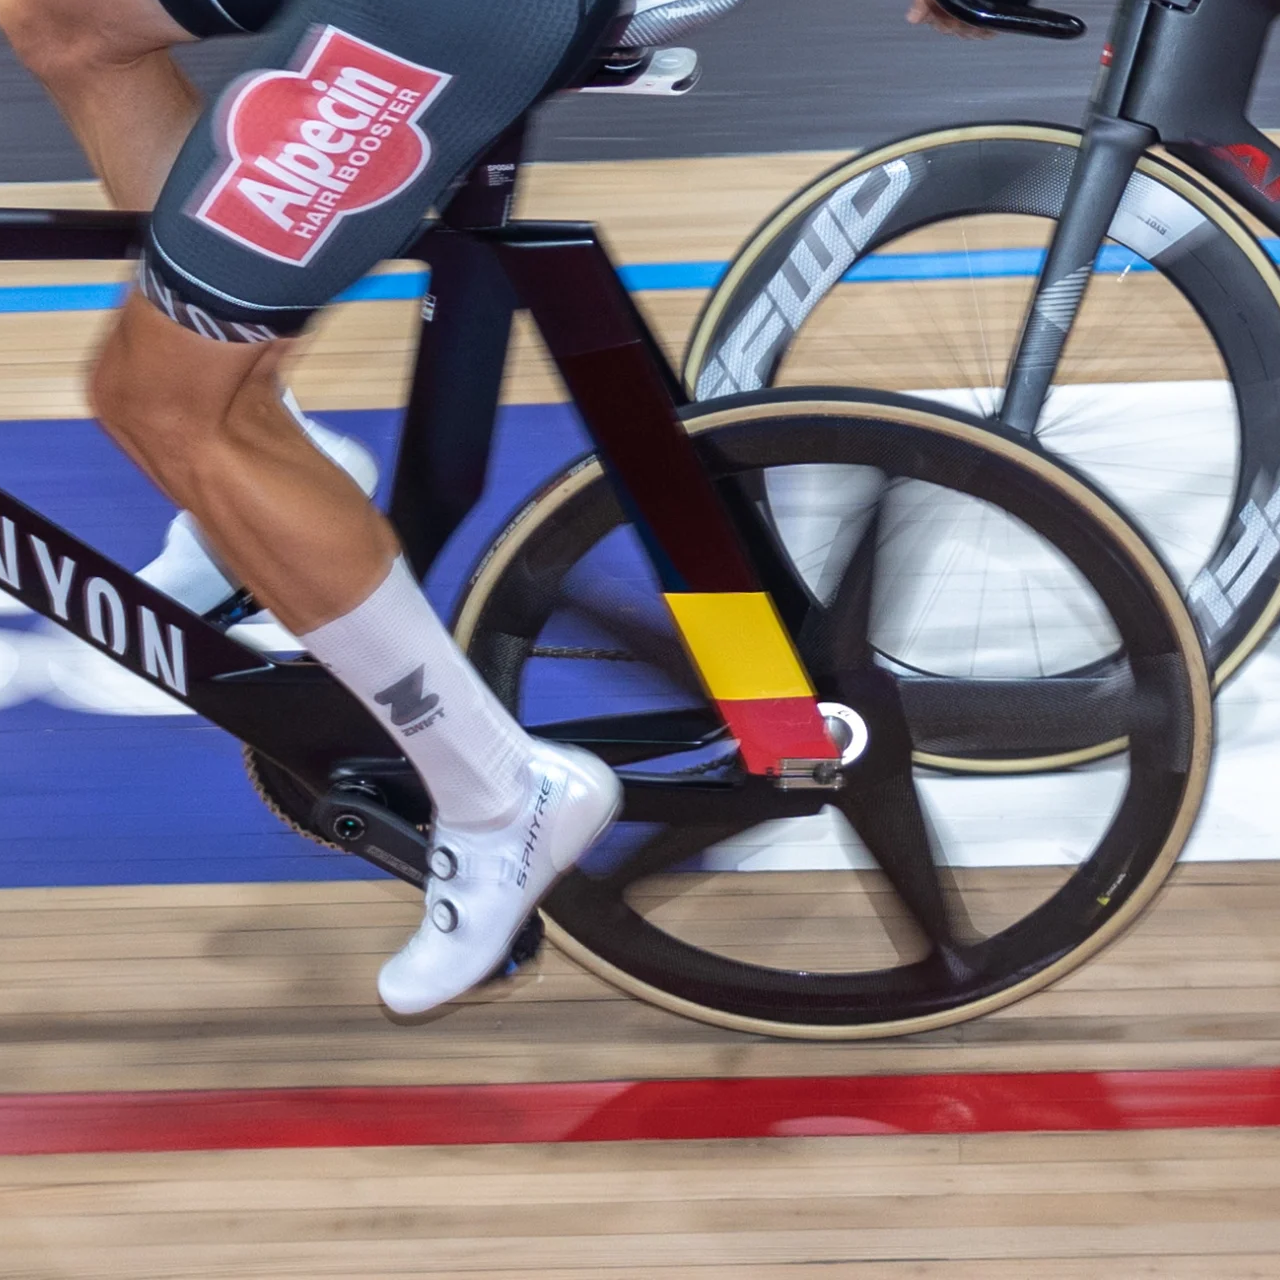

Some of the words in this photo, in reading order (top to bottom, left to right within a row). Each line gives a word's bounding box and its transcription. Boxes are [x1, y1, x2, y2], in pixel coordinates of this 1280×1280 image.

[237, 66, 398, 232] Alpecin
[293, 190, 342, 239] HAIR
[337, 88, 422, 182] BOOSTER
[516, 774, 554, 890] S-PHYRE
